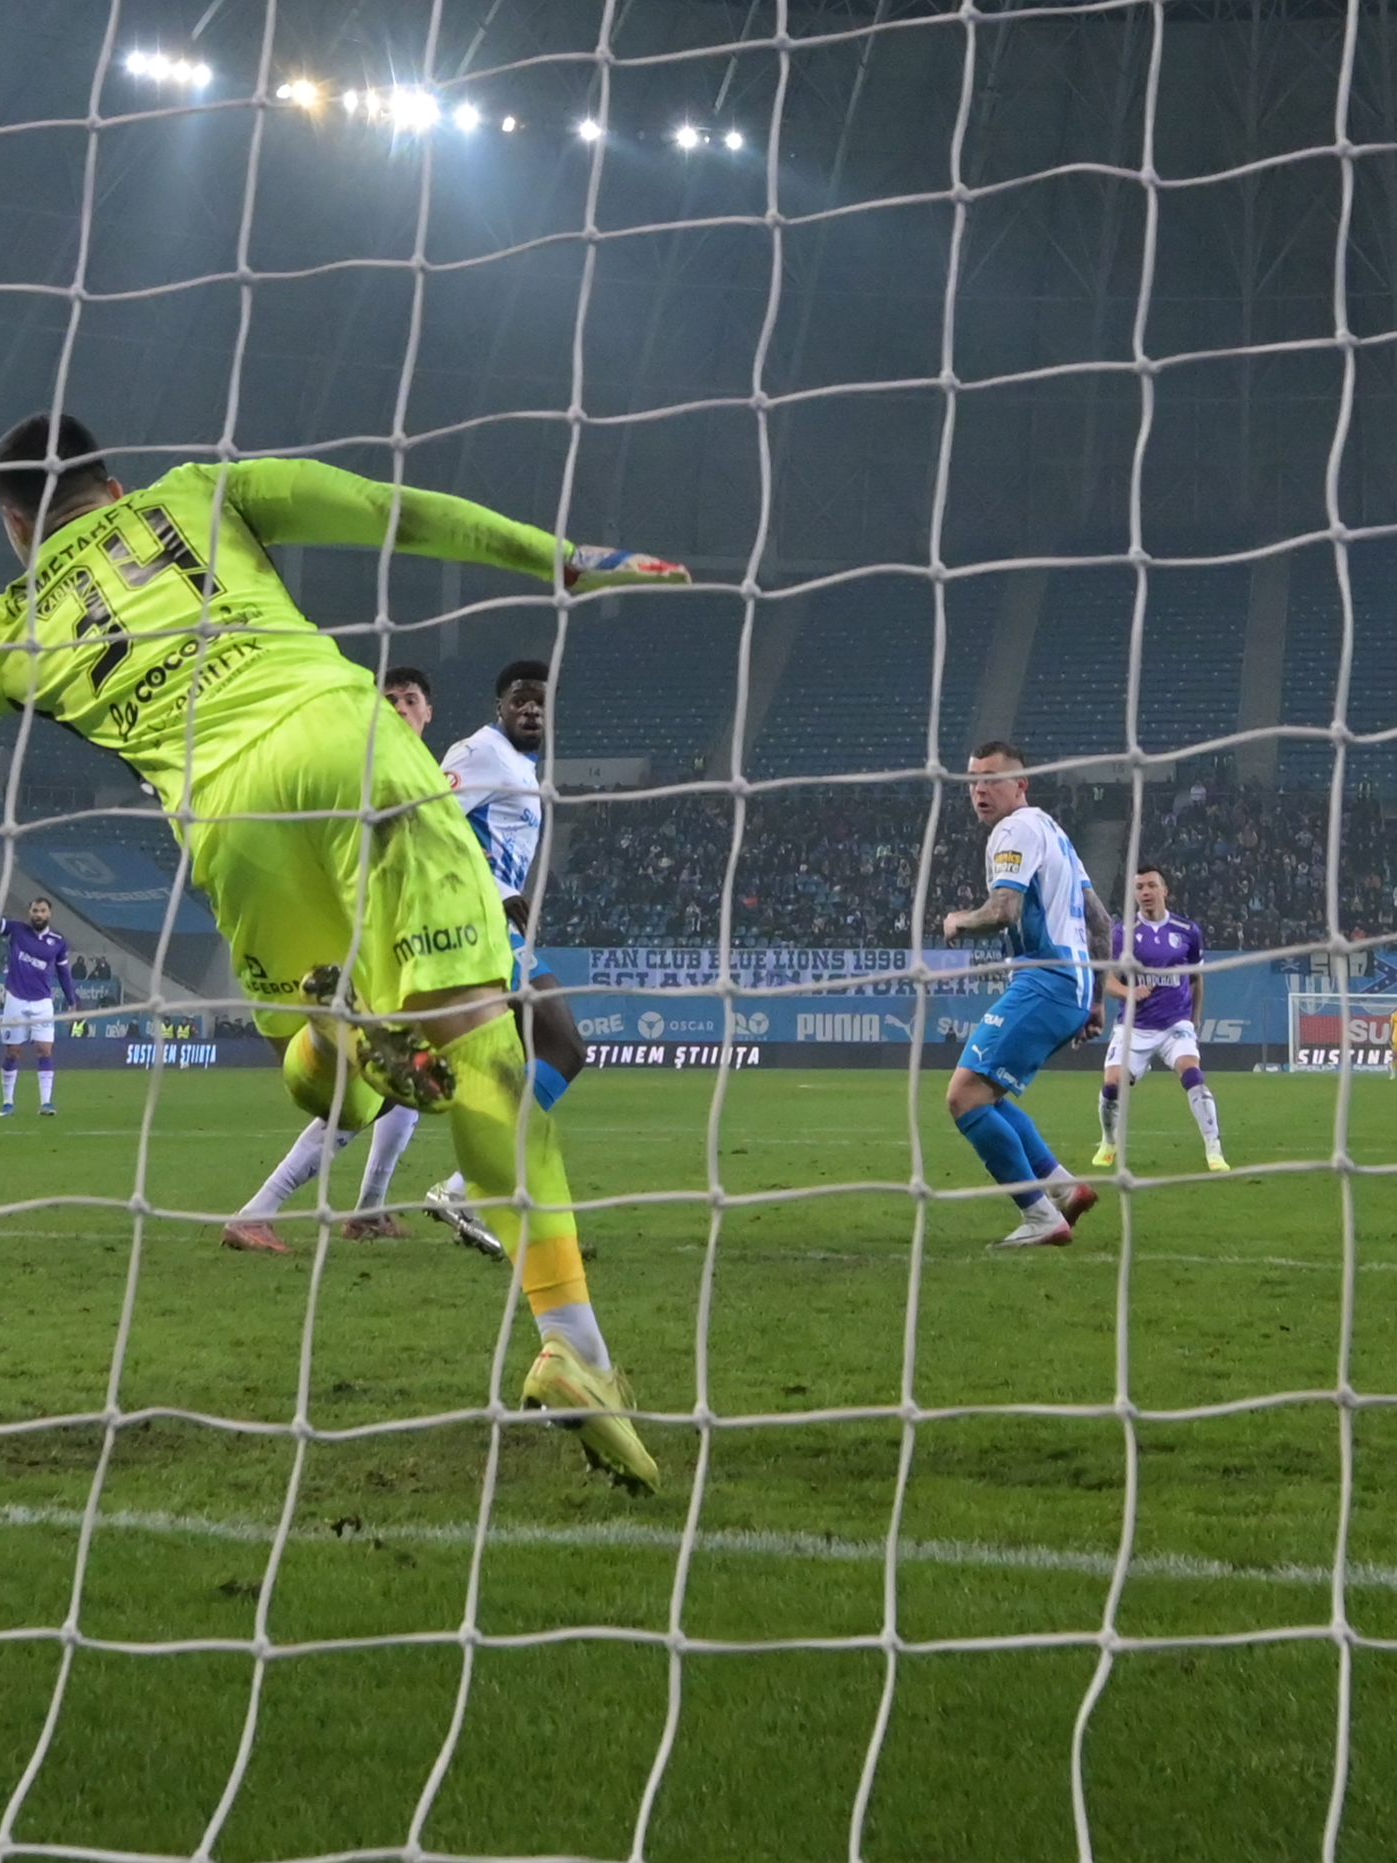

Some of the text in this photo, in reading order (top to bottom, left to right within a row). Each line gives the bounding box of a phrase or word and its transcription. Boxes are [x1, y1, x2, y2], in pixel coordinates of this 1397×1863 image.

[393, 923, 479, 967] maia.ro
[591, 949, 906, 971] FAN CLUB BLUE LIONS 1998
[576, 1012, 625, 1037] ORE
[670, 1020, 714, 1032] OSCAR
[797, 1013, 881, 1042] PUMA
[126, 1043, 177, 1070] SUSȚIEM
[585, 1045, 665, 1069] SȚINEM
